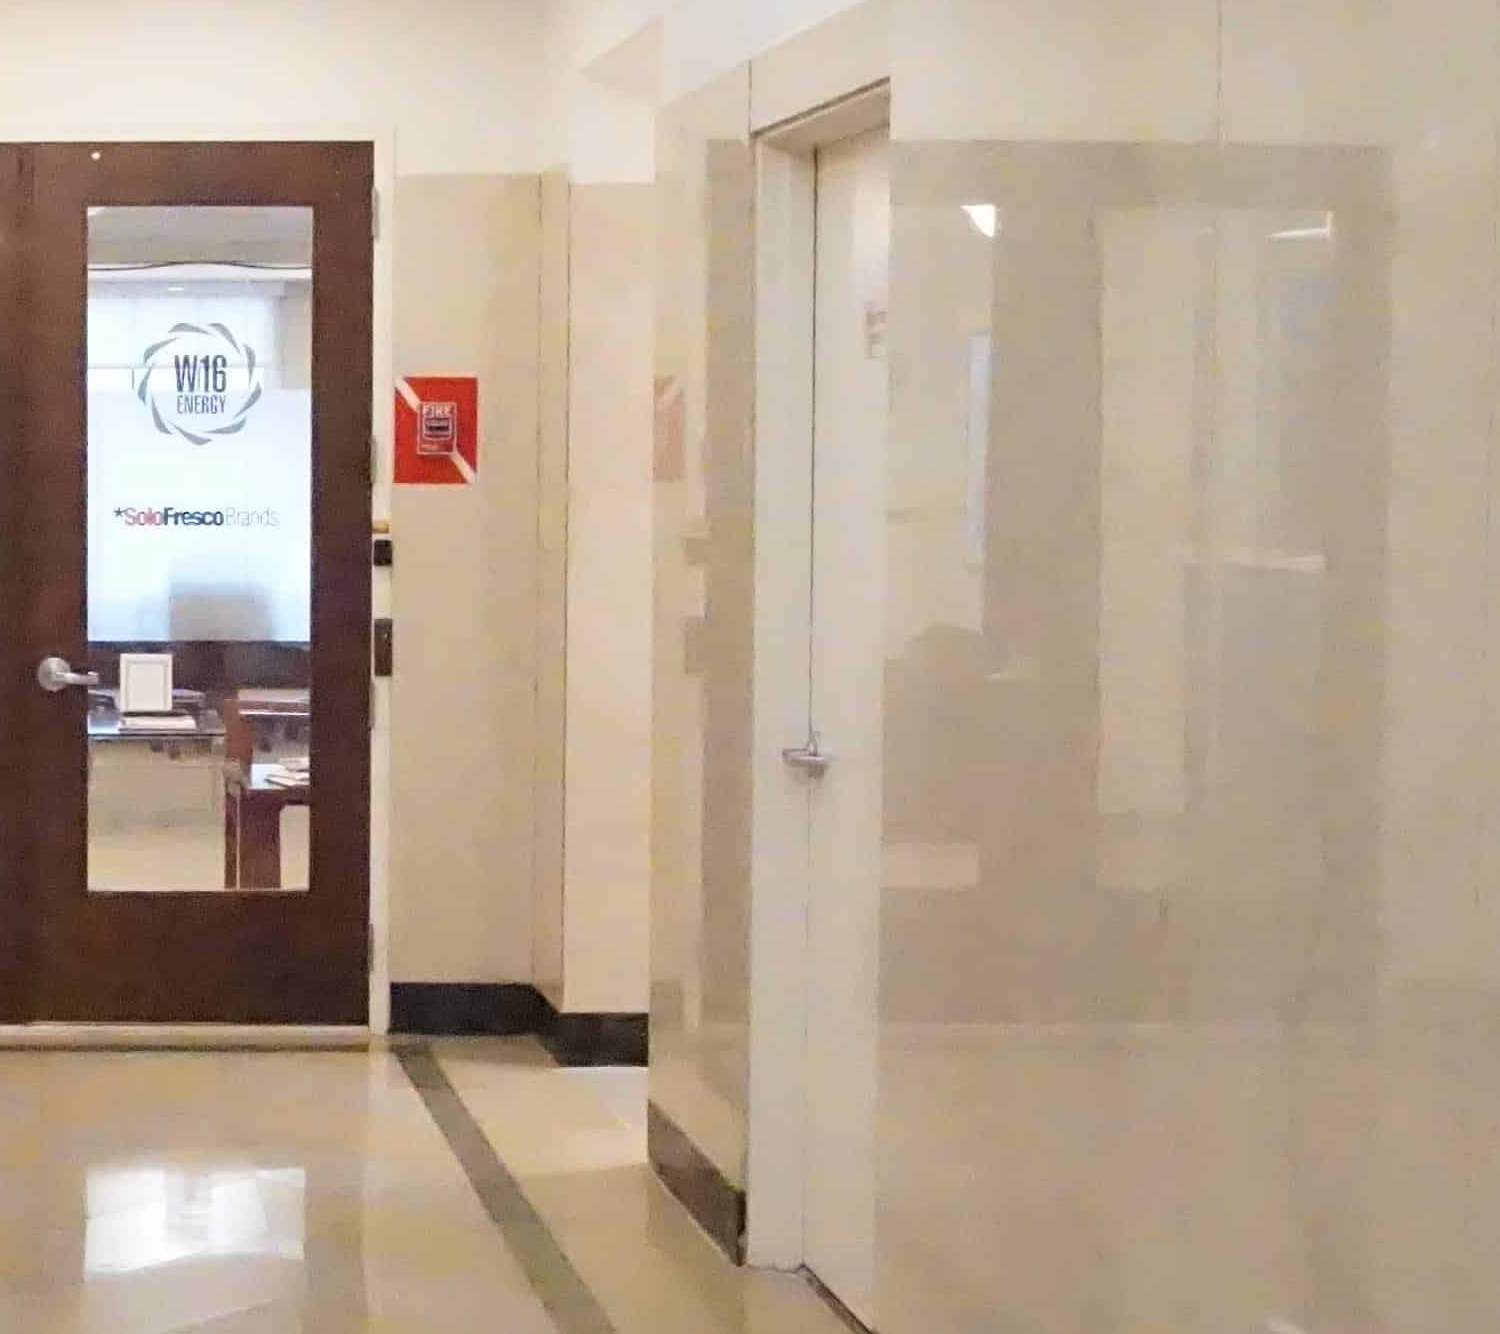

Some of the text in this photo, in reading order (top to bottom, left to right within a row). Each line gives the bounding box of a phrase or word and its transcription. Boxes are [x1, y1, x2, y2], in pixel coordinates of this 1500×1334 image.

[174, 354, 227, 393] W16
[176, 395, 227, 415] ENERGY
[423, 404, 453, 417] FIRE
